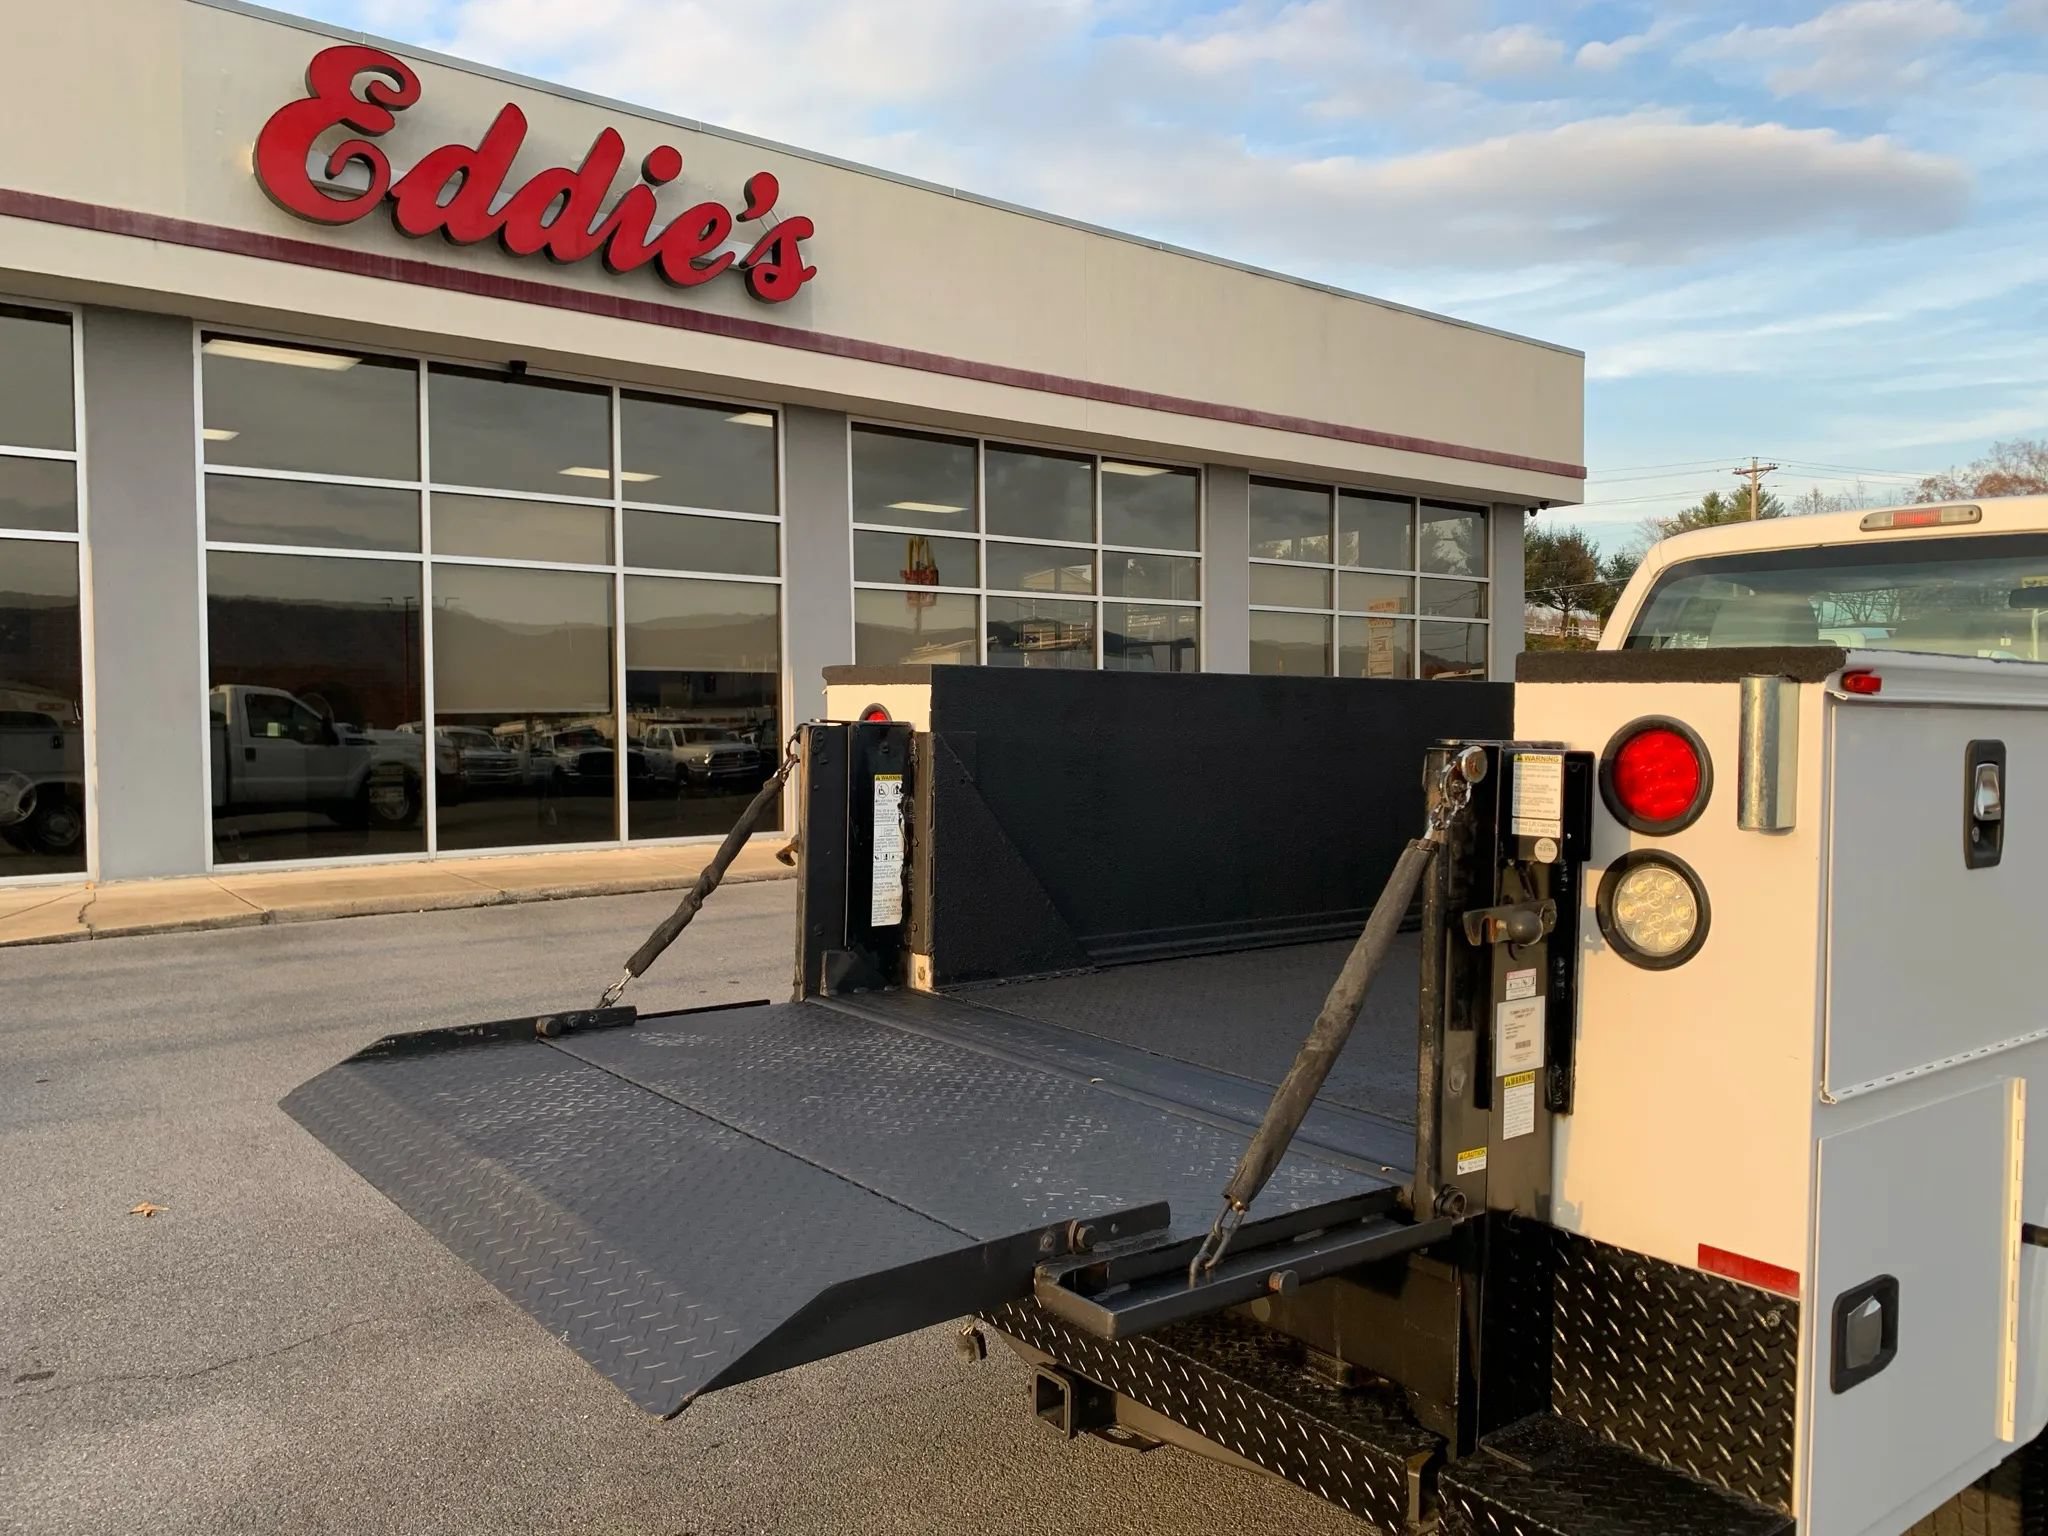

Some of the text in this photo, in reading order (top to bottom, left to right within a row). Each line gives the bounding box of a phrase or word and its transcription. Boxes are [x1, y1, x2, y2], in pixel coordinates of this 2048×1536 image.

[253, 45, 817, 303] Eddie's
[1511, 1072, 1534, 1085] WARNING
[1463, 1149, 1486, 1159] CAUTION
